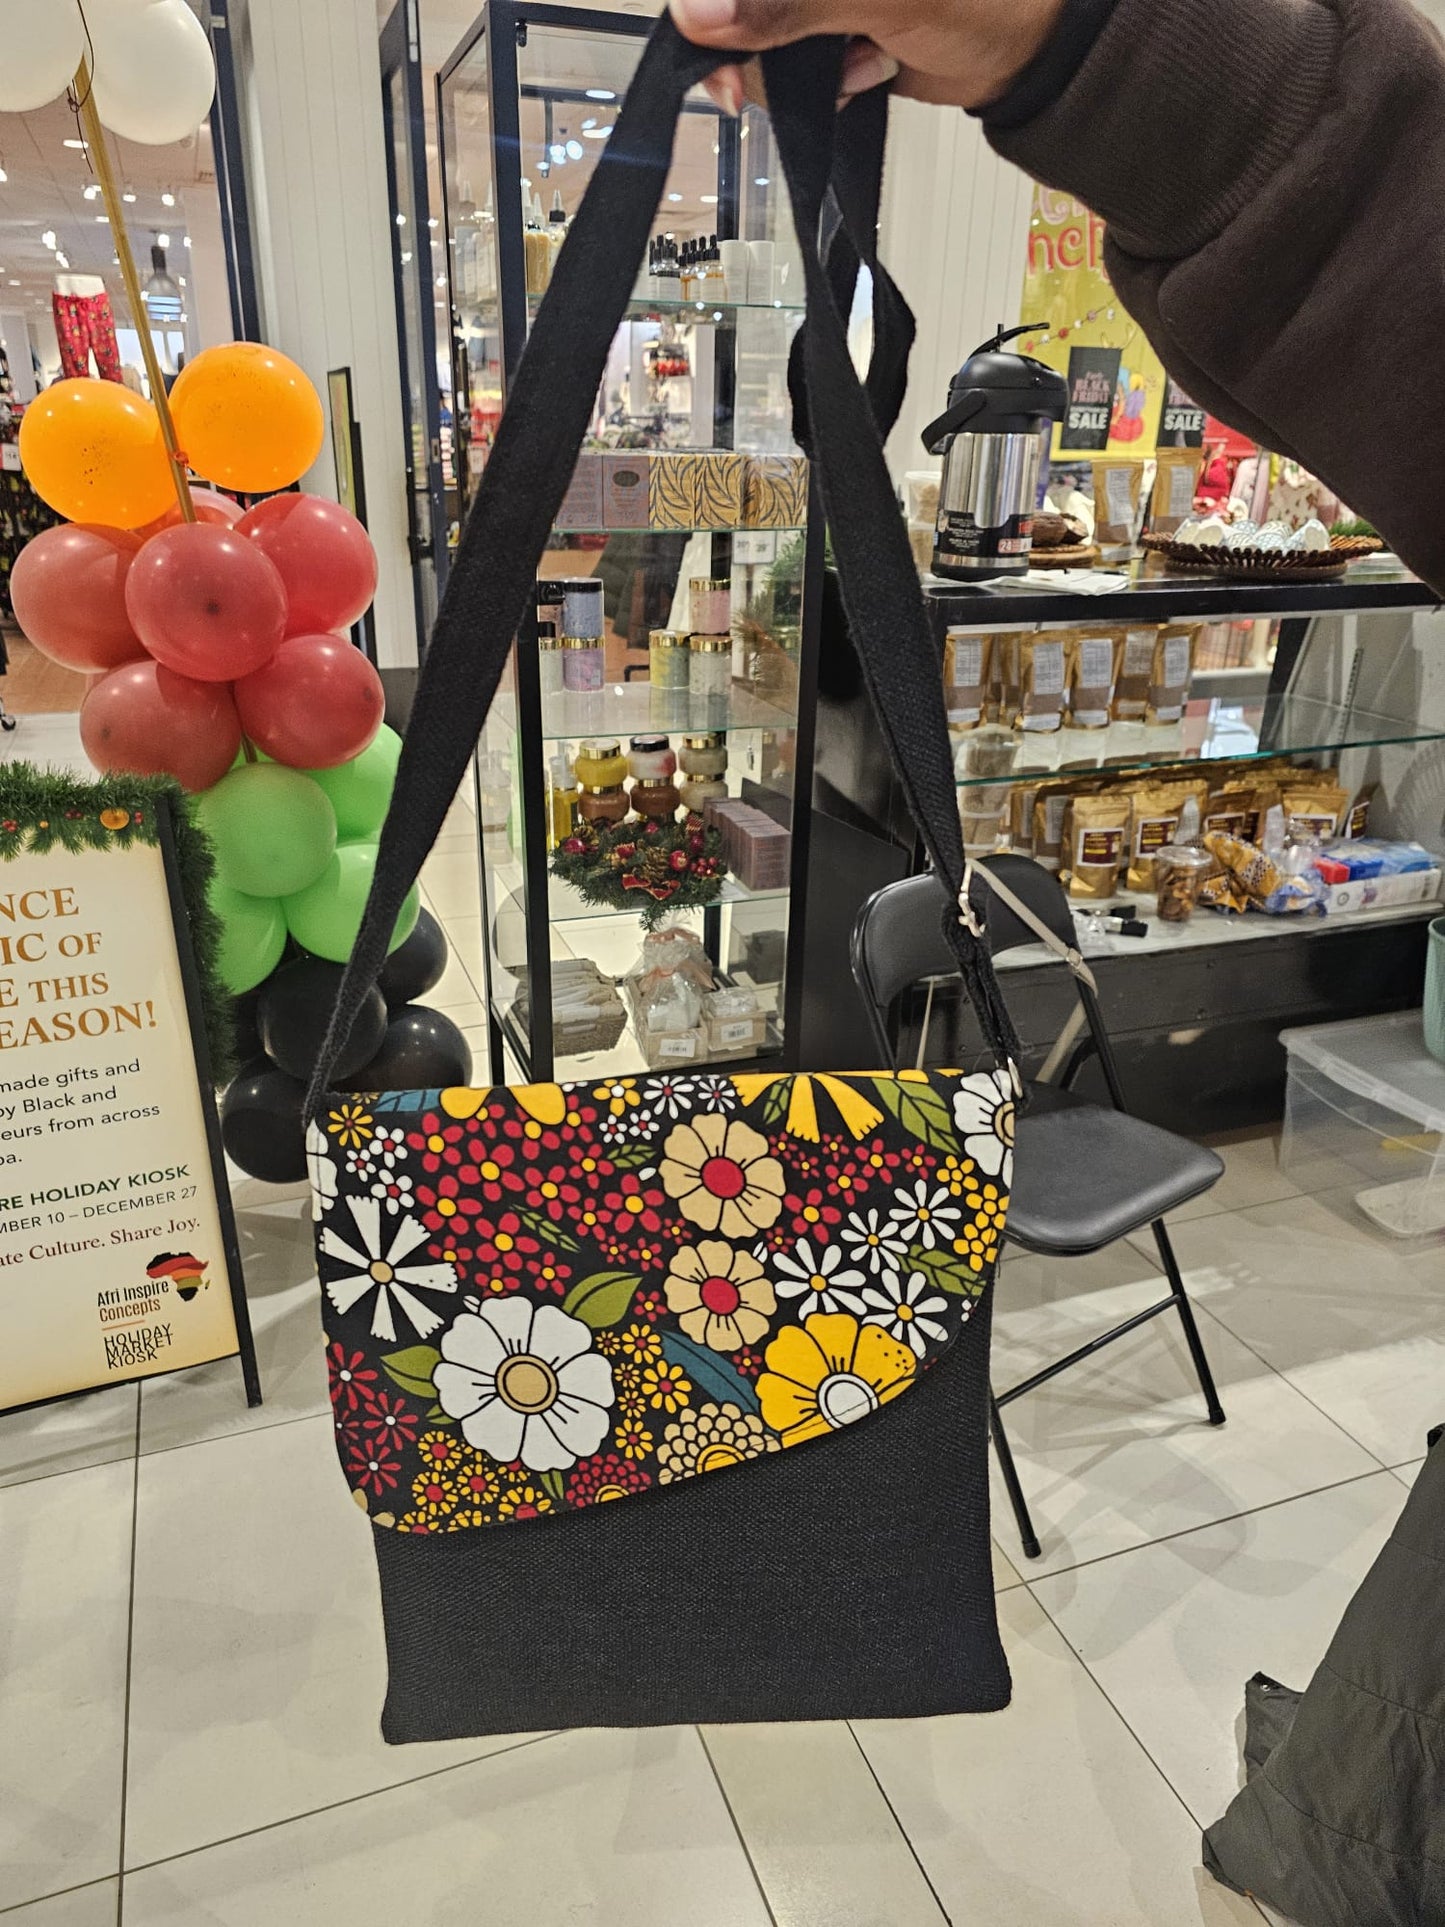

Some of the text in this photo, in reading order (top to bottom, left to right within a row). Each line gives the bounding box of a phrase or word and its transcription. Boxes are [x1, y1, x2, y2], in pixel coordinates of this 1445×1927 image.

[1068, 411, 1108, 430] SALE
[1163, 413, 1202, 431] SALE
[58, 932, 102, 957] OF
[28, 972, 109, 1004] THIS
[56, 1067, 99, 1088] gifts
[105, 1058, 141, 1077] and
[23, 1093, 75, 1113] Black
[82, 1085, 117, 1104] and
[1, 1105, 160, 1141] eurs from across
[31, 1177, 121, 1206] HOLIDAY
[128, 1164, 190, 1188] KIOSK
[48, 1212, 65, 1224] 10
[83, 1191, 176, 1218] DECEMBER
[181, 1185, 198, 1200] 27
[29, 1236, 105, 1260] Culture.
[110, 1225, 163, 1245] Share
[167, 1217, 200, 1234] Joy.
[98, 1280, 169, 1307] Afri Inspire
[100, 1298, 161, 1322] Concepts
[104, 1323, 171, 1349] HOLIDAY
[106, 1333, 174, 1358] MARKET
[107, 1347, 158, 1369] KIOSK
